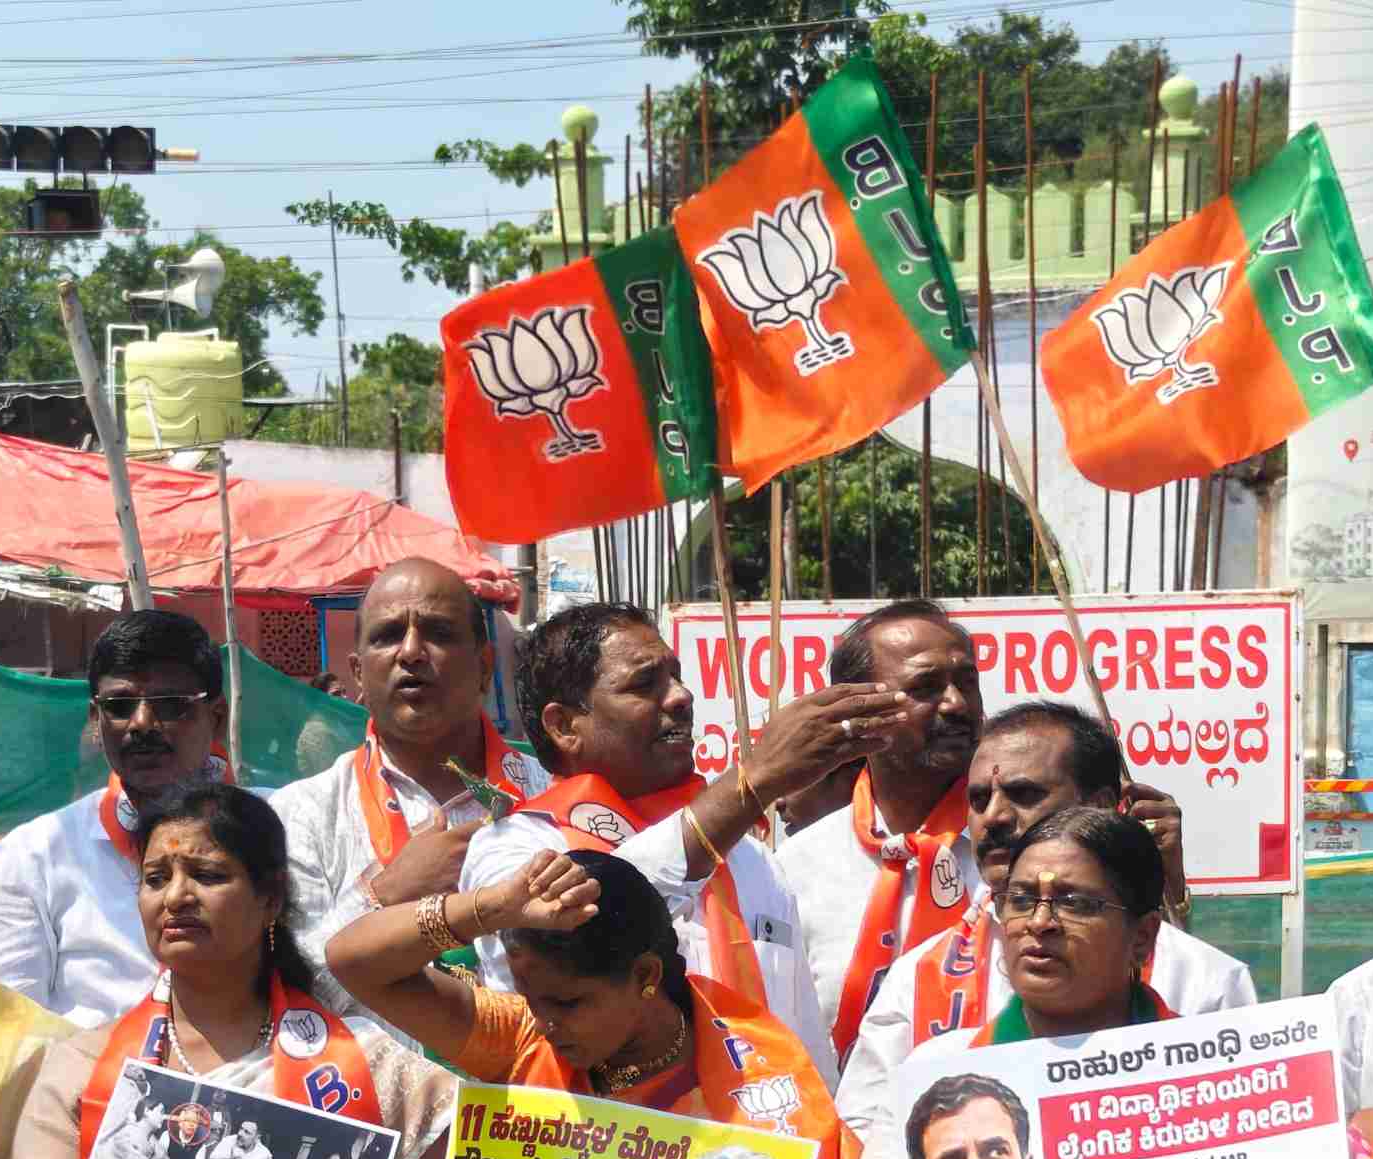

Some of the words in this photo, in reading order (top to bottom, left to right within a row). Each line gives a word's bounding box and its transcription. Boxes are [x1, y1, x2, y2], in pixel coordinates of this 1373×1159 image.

[695, 635, 842, 699] WOR
[970, 624, 1268, 694] PROGRESS
[1047, 1042, 1157, 1084] ರಾಹುಲ್
[1163, 1027, 1242, 1069] ಗಾಂಧಿ
[1249, 1021, 1318, 1051] ಅವರೇ
[460, 1104, 487, 1141] 11
[1069, 1101, 1092, 1123] 11
[1236, 1097, 1314, 1134] ನೀಡಿದ
